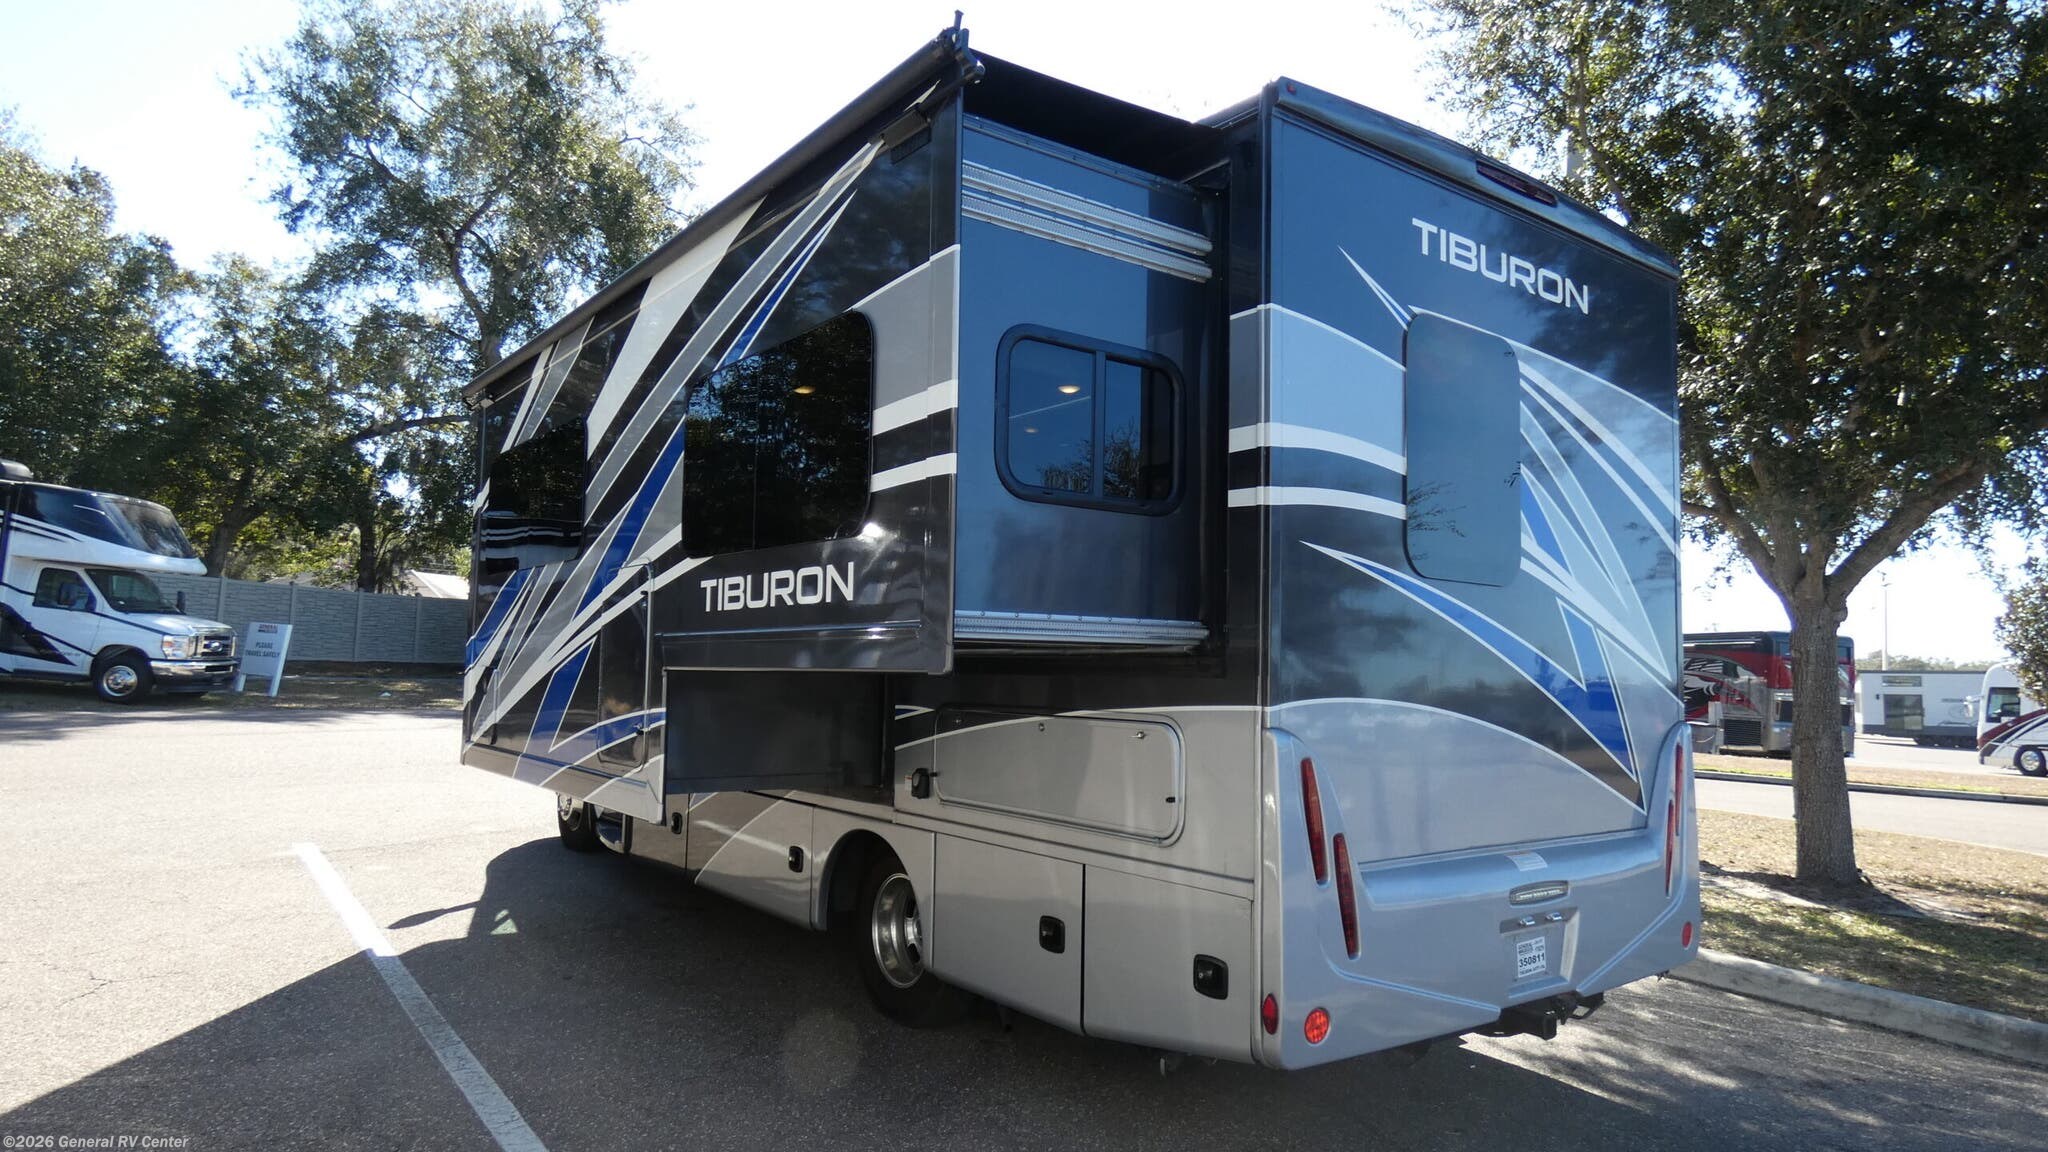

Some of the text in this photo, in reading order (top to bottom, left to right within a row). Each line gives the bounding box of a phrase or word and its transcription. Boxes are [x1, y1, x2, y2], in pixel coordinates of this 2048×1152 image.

[1412, 217, 1589, 315] TIBURON
[700, 561, 855, 612] TIBURON
[1519, 952, 1544, 967] 350811
